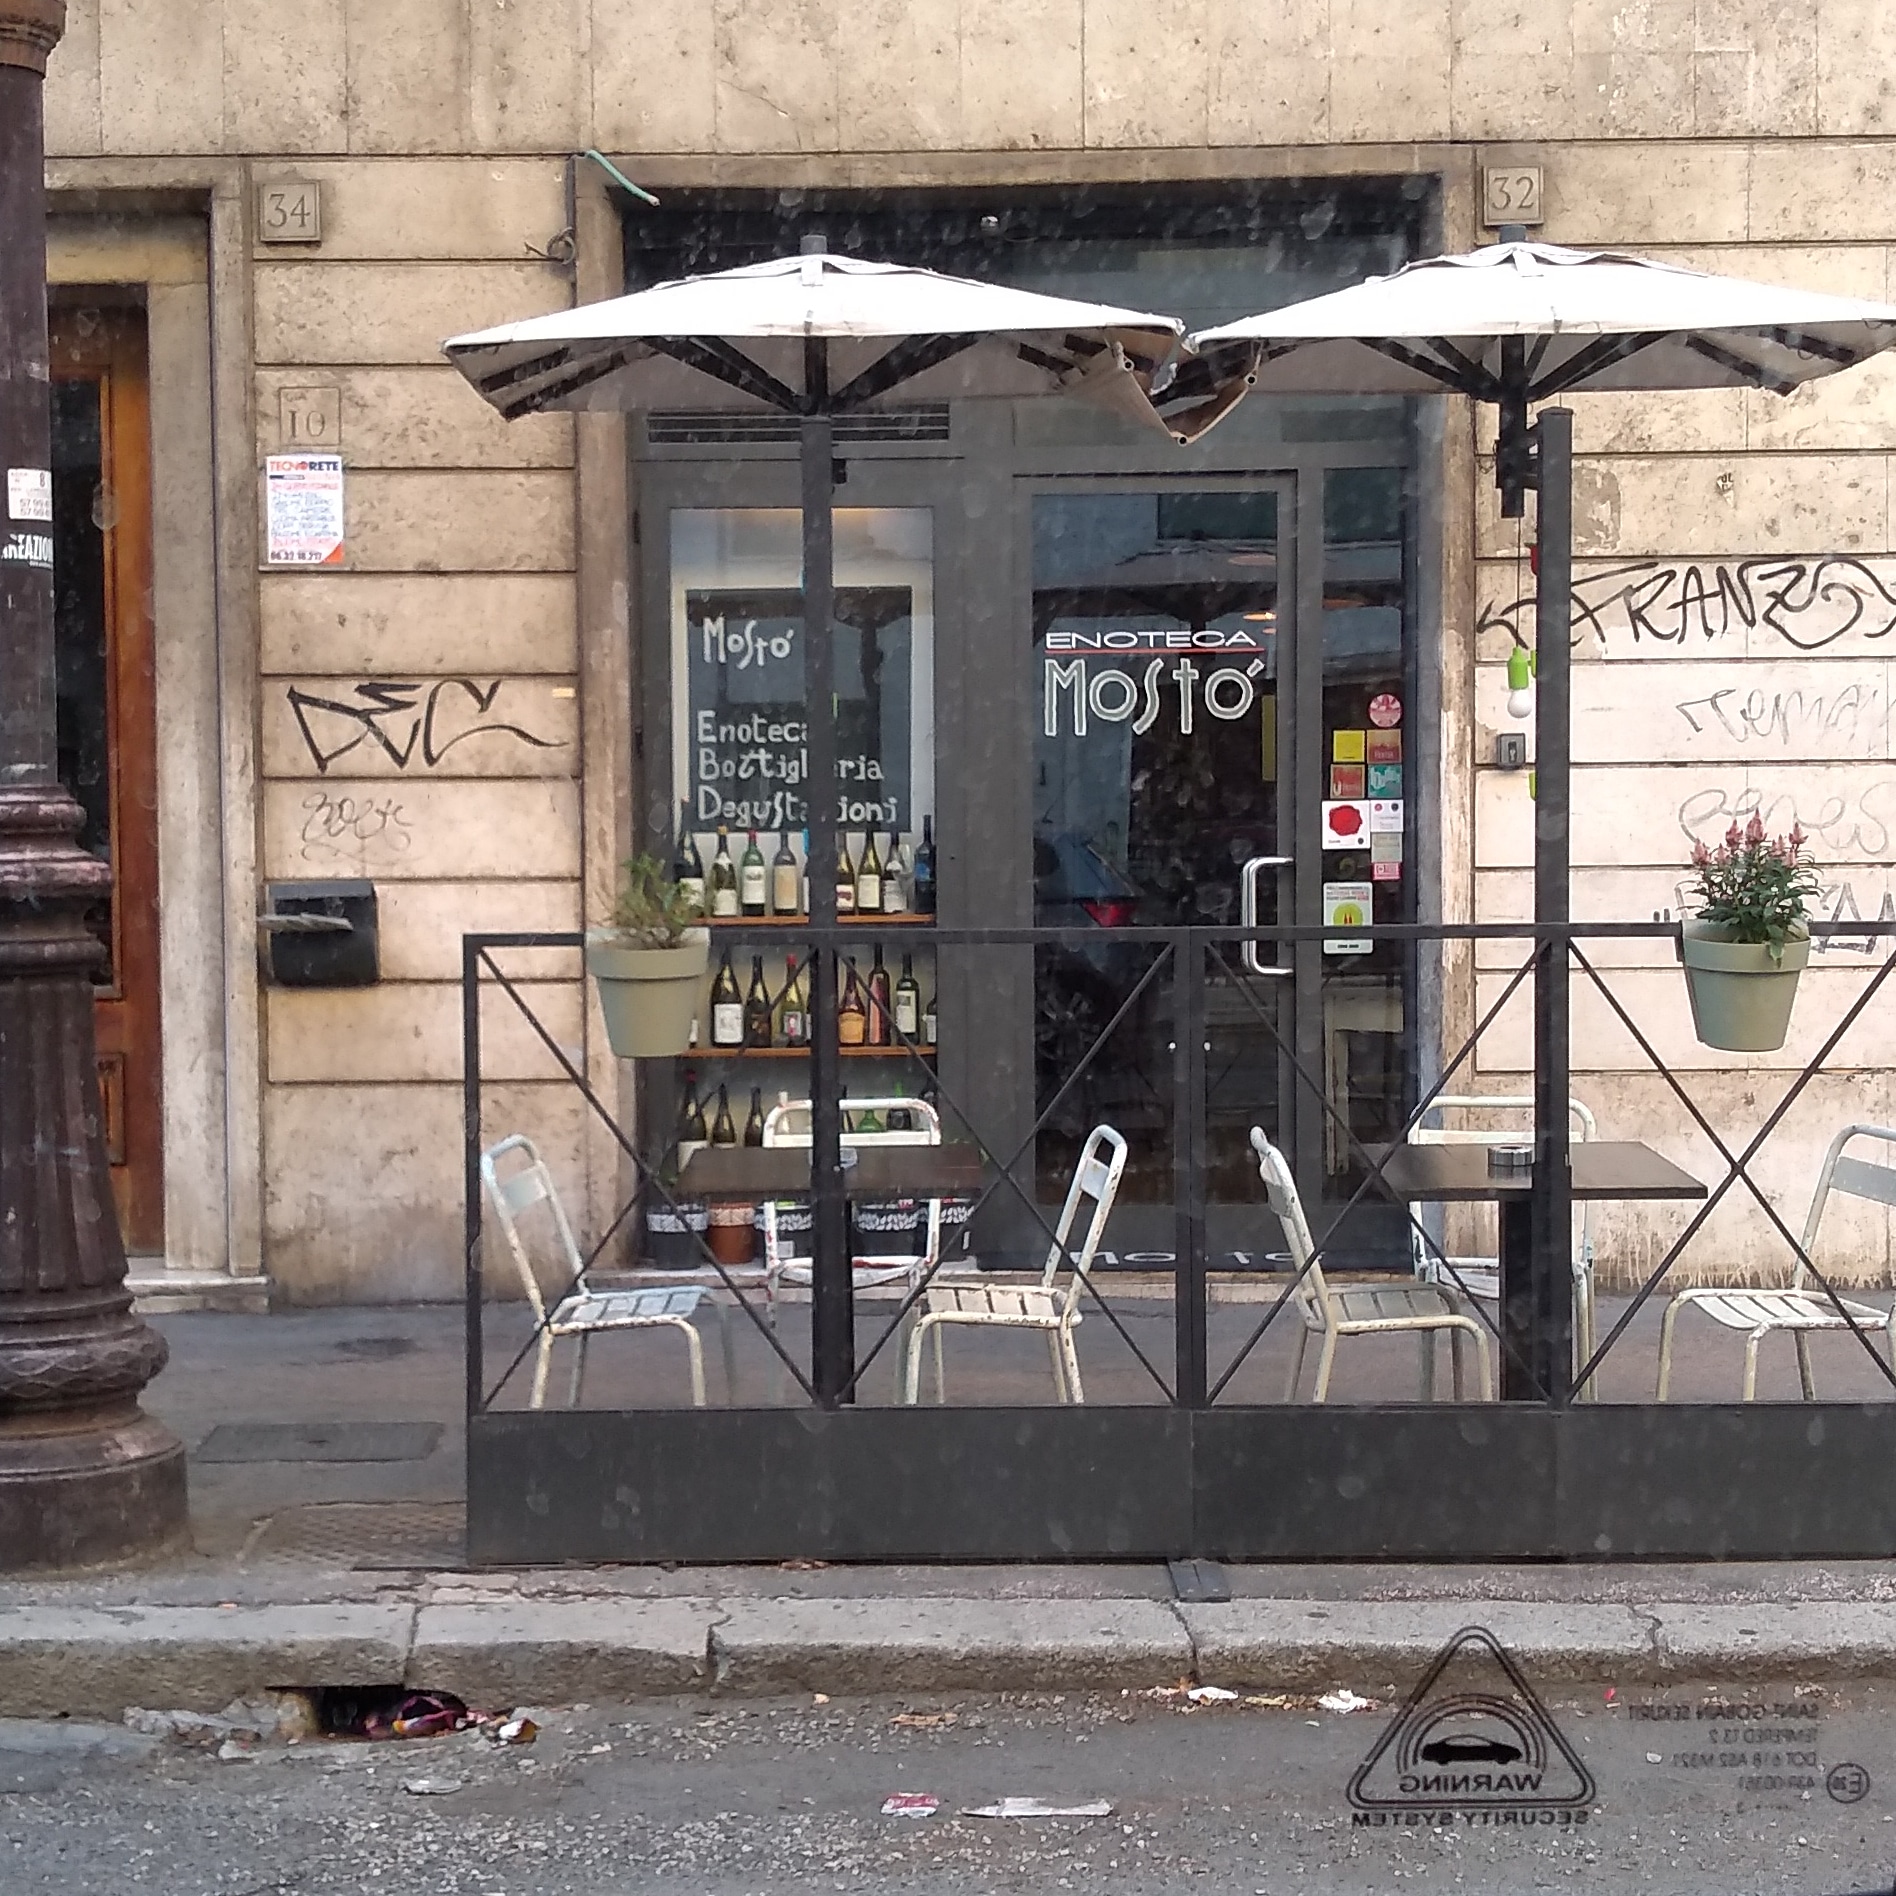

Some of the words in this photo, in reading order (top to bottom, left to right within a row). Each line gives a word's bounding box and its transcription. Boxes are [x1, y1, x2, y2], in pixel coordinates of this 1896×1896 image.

[266, 193, 311, 229] 34
[1491, 175, 1536, 211] 32
[1045, 630, 1257, 649] ENOTECA
[698, 710, 808, 744] Enotec
[699, 748, 885, 784] Bottiglria
[698, 784, 898, 829] Degustioni
